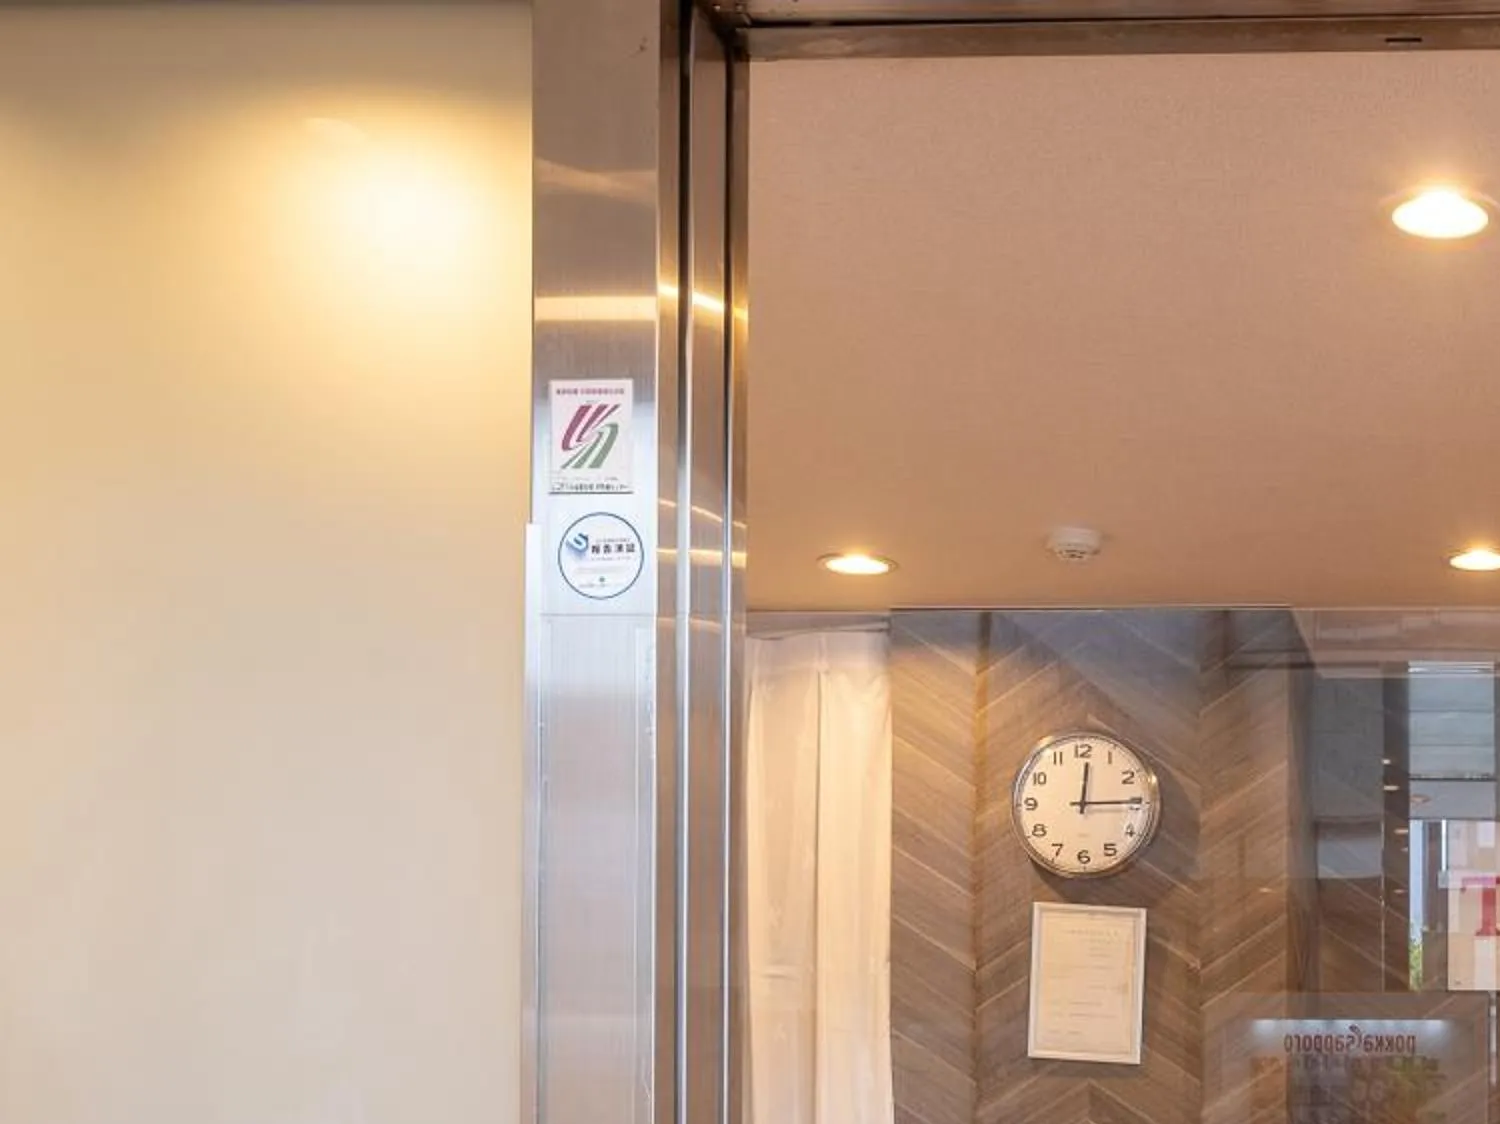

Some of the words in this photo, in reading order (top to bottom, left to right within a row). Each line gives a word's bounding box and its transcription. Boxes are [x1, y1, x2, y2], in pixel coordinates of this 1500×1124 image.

[1053, 751, 1063, 765] 11
[1073, 743, 1092, 759] 12
[1032, 771, 1047, 786] 10
[1121, 771, 1136, 785] 2
[1024, 797, 1038, 811] 9
[1032, 823, 1047, 838] 8
[1125, 823, 1136, 838] 4
[1051, 843, 1064, 858] 7
[1077, 850, 1091, 865] 6
[1103, 843, 1117, 858] 5
